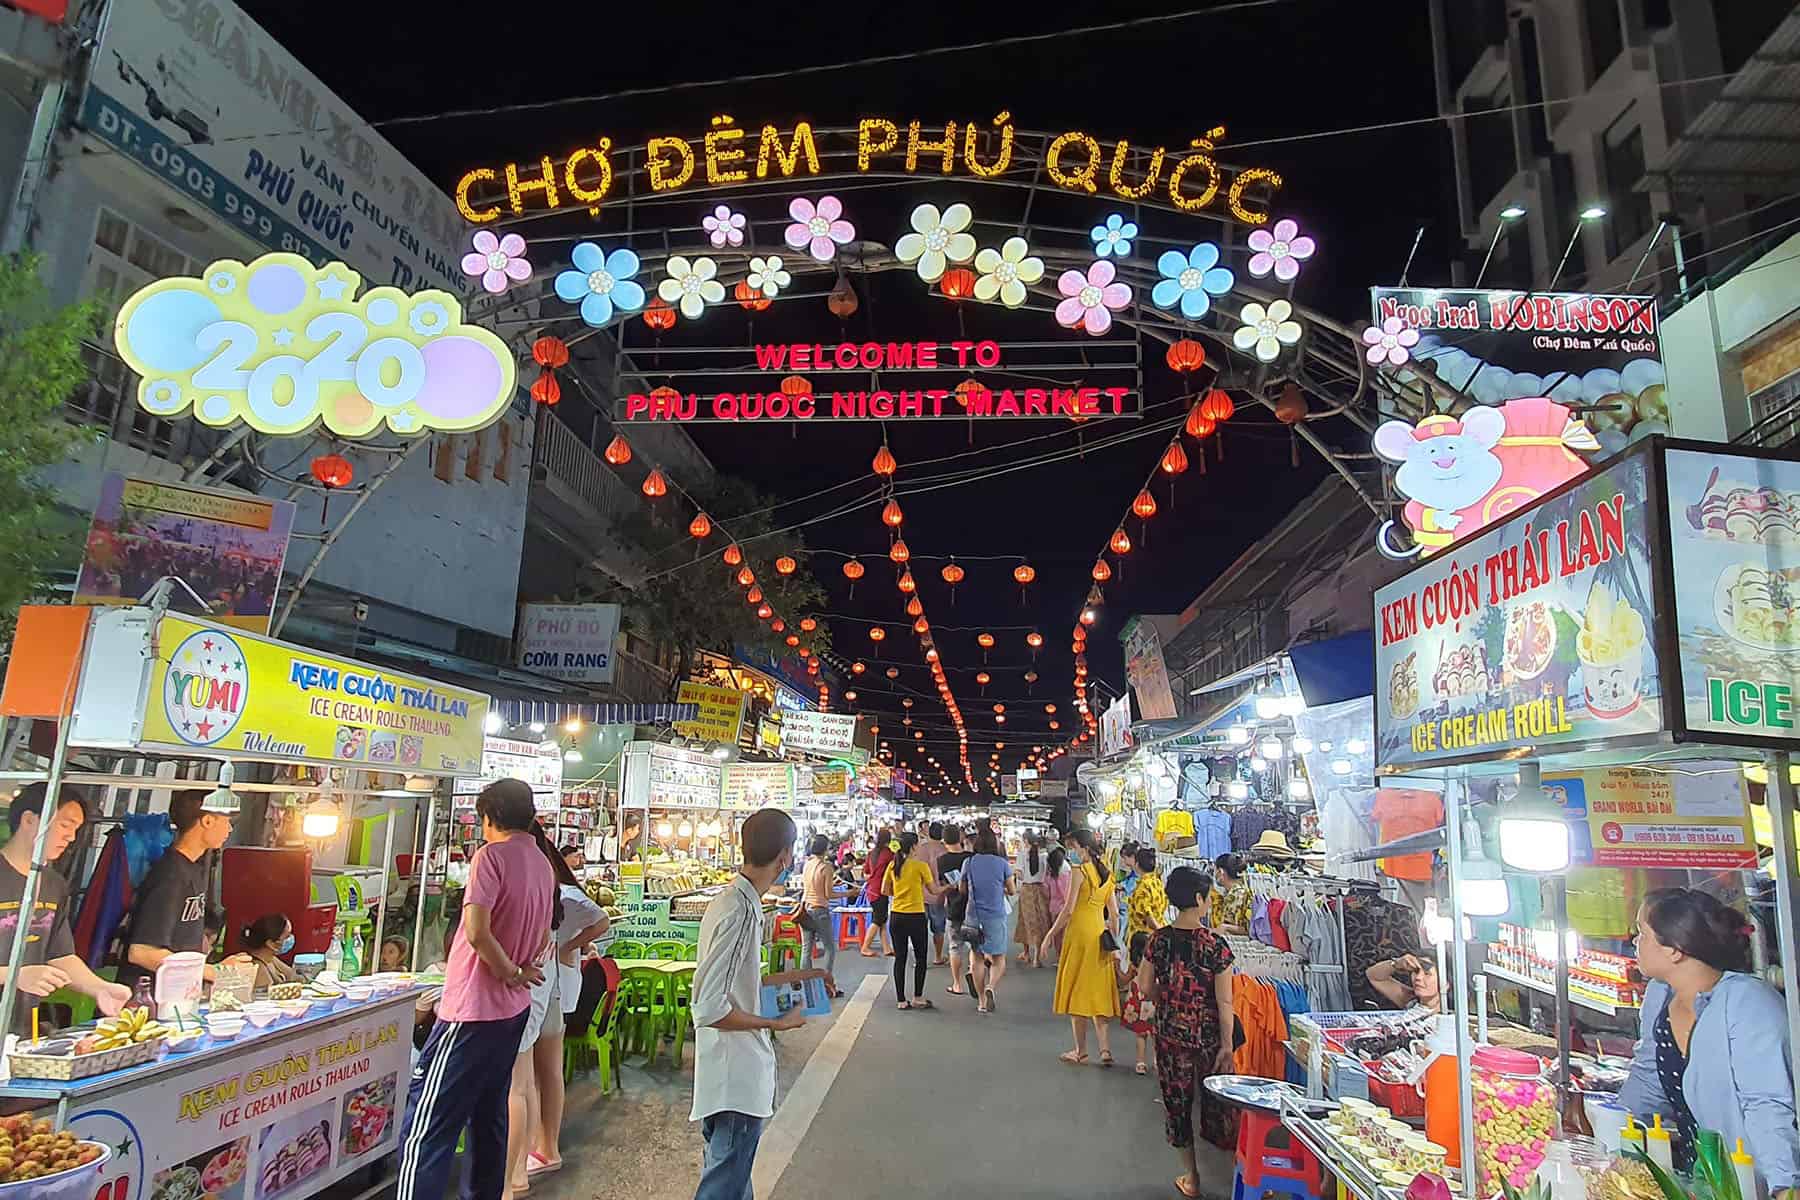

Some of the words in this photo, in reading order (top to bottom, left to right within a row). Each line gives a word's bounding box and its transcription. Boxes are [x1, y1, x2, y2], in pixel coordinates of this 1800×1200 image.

[99, 105, 142, 147] ĐT:
[151, 142, 216, 201] 0903
[225, 193, 273, 237] 999
[456, 136, 612, 223] CHỢ
[644, 114, 820, 191] ĐÊM
[858, 111, 1013, 177] PHÚ
[1046, 126, 1283, 224] QUỐC
[244, 148, 296, 206] PHÚ
[297, 189, 354, 251] QUỐC
[300, 145, 345, 195] VẬN
[352, 190, 420, 256] CHUYỂN
[425, 248, 467, 295] HÀNG
[1434, 299, 1480, 329] Trai
[1490, 295, 1654, 334] ROBINSON
[191, 311, 427, 426] 2020
[754, 342, 938, 371] WELCOME
[952, 340, 1000, 369] TO
[1533, 336, 1561, 351] (Chợ
[1563, 336, 1591, 350] Đêm
[1620, 337, 1656, 352] Quốc)
[625, 393, 697, 422] PHU
[712, 392, 816, 423] QUOC
[831, 391, 949, 419] NIGHT
[966, 387, 1130, 417] MARKET
[1381, 592, 1418, 647] KEM
[1421, 560, 1480, 633] CUỘN
[1485, 522, 1551, 606] THÁI
[1557, 493, 1625, 578] LAN
[523, 650, 559, 667] CƠM
[563, 652, 607, 668] RANG
[171, 669, 242, 714] YUMI
[290, 660, 339, 691] KEM
[343, 674, 396, 705] CUỘN
[400, 688, 437, 713] THÁI
[440, 698, 470, 720] LAN
[310, 697, 330, 717] ICE
[333, 701, 374, 725] CREAM
[376, 709, 407, 729] ROLLS
[409, 715, 451, 737] THAILAND
[1707, 677, 1794, 728] ICE
[243, 731, 306, 756] Welcome
[1411, 722, 1437, 753] ICE
[1441, 708, 1509, 751] CREAM
[1514, 695, 1573, 740] ROLL
[178, 1076, 241, 1121] KEM
[244, 1051, 311, 1094] CUỘN
[316, 1033, 361, 1066] THÁI
[366, 1024, 398, 1049] LAN
[218, 1108, 239, 1130] ICE
[244, 1092, 287, 1120] CREAM
[290, 1081, 322, 1102] ROLLS
[325, 1058, 370, 1086] THAILAND
